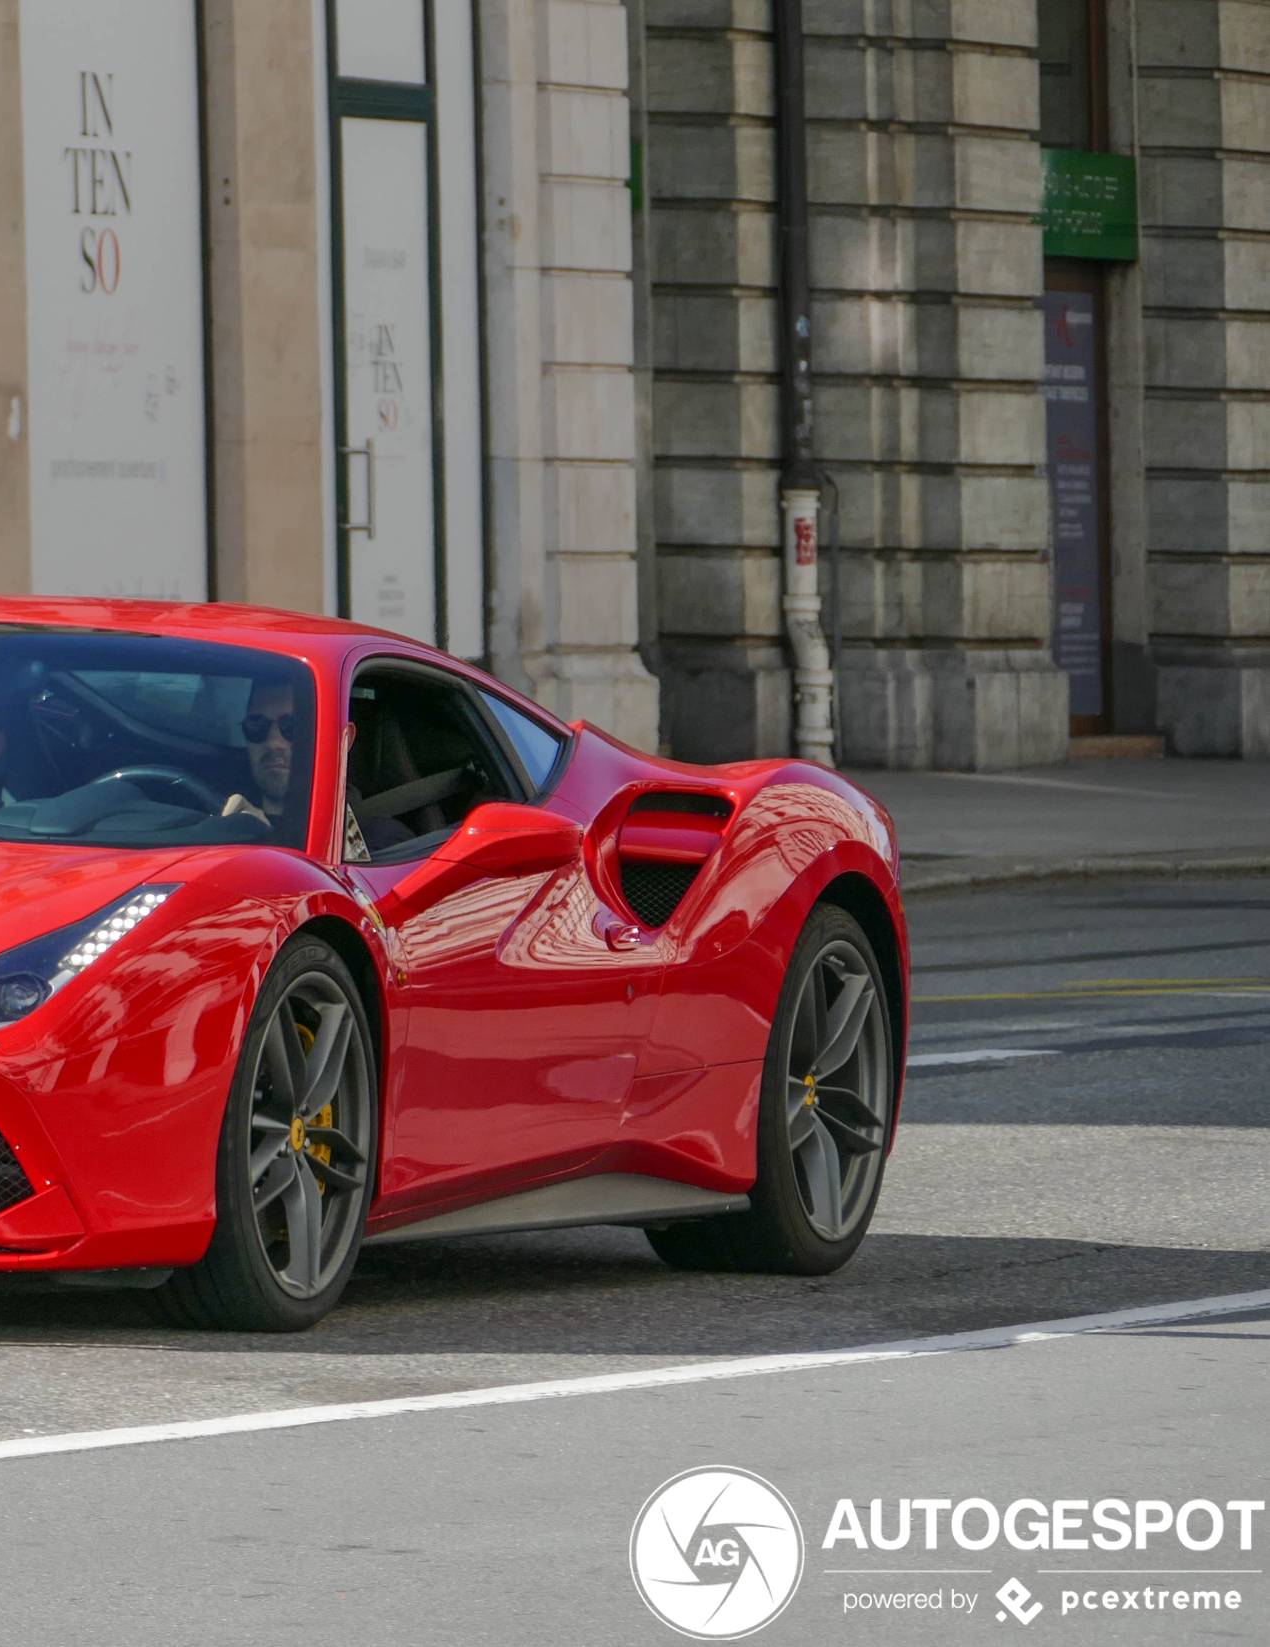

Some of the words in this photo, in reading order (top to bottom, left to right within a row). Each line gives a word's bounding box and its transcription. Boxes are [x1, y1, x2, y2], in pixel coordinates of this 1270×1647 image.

[79, 70, 114, 138] IN
[64, 147, 133, 217] TEN
[80, 226, 122, 294] SO
[371, 360, 403, 394] TEN
